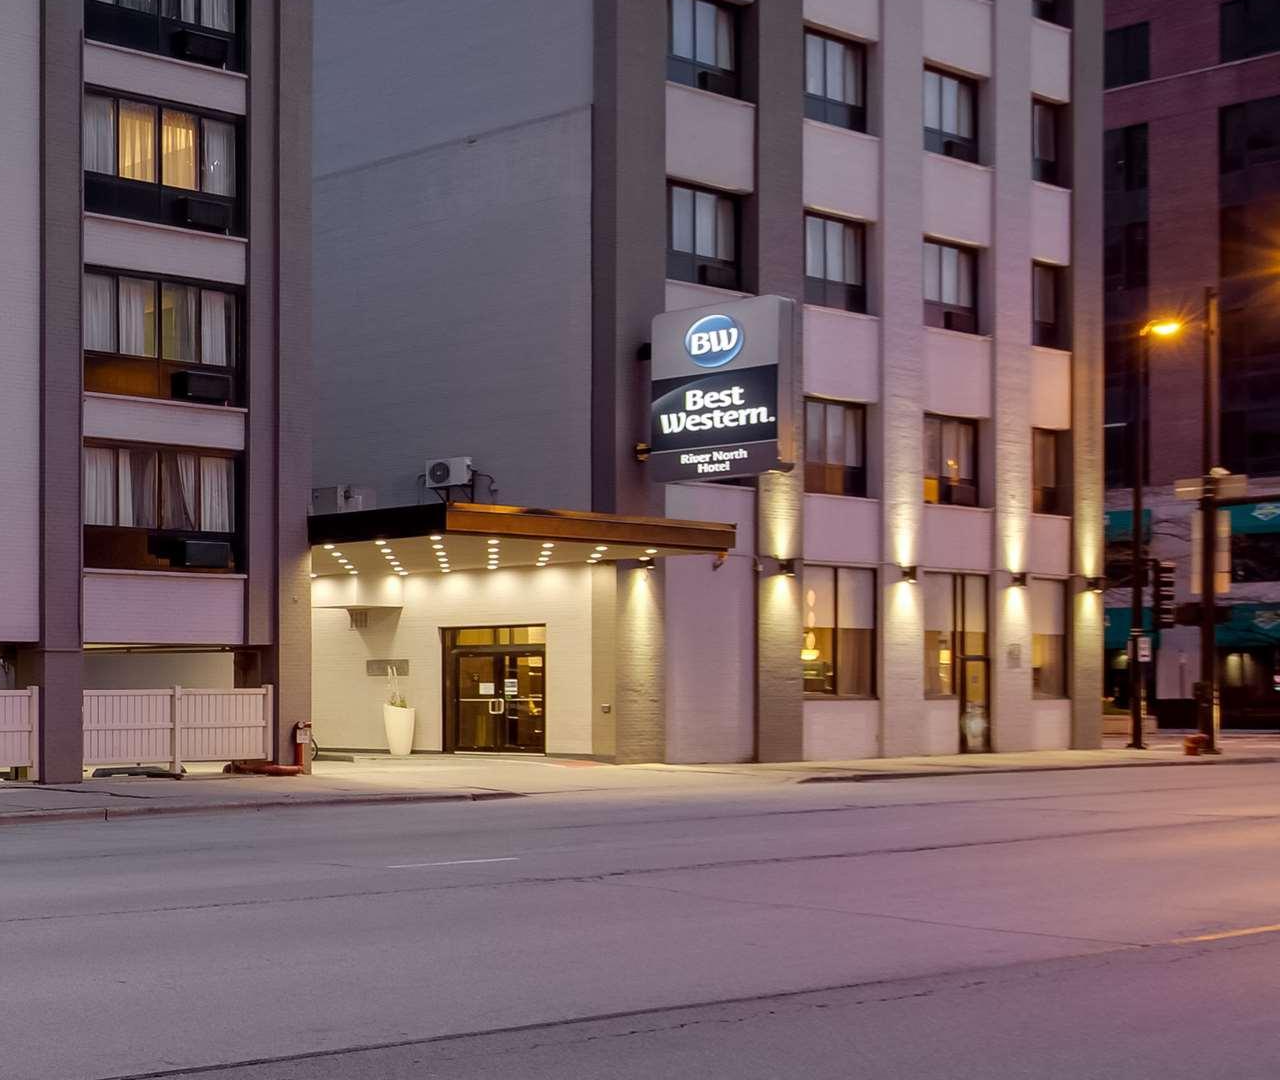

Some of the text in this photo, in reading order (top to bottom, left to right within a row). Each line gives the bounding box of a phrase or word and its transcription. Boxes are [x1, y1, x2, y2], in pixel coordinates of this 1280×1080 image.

[690, 327, 738, 355] BW
[685, 386, 745, 411] Best
[680, 448, 748, 464] River North
[697, 461, 730, 473] Hotel
